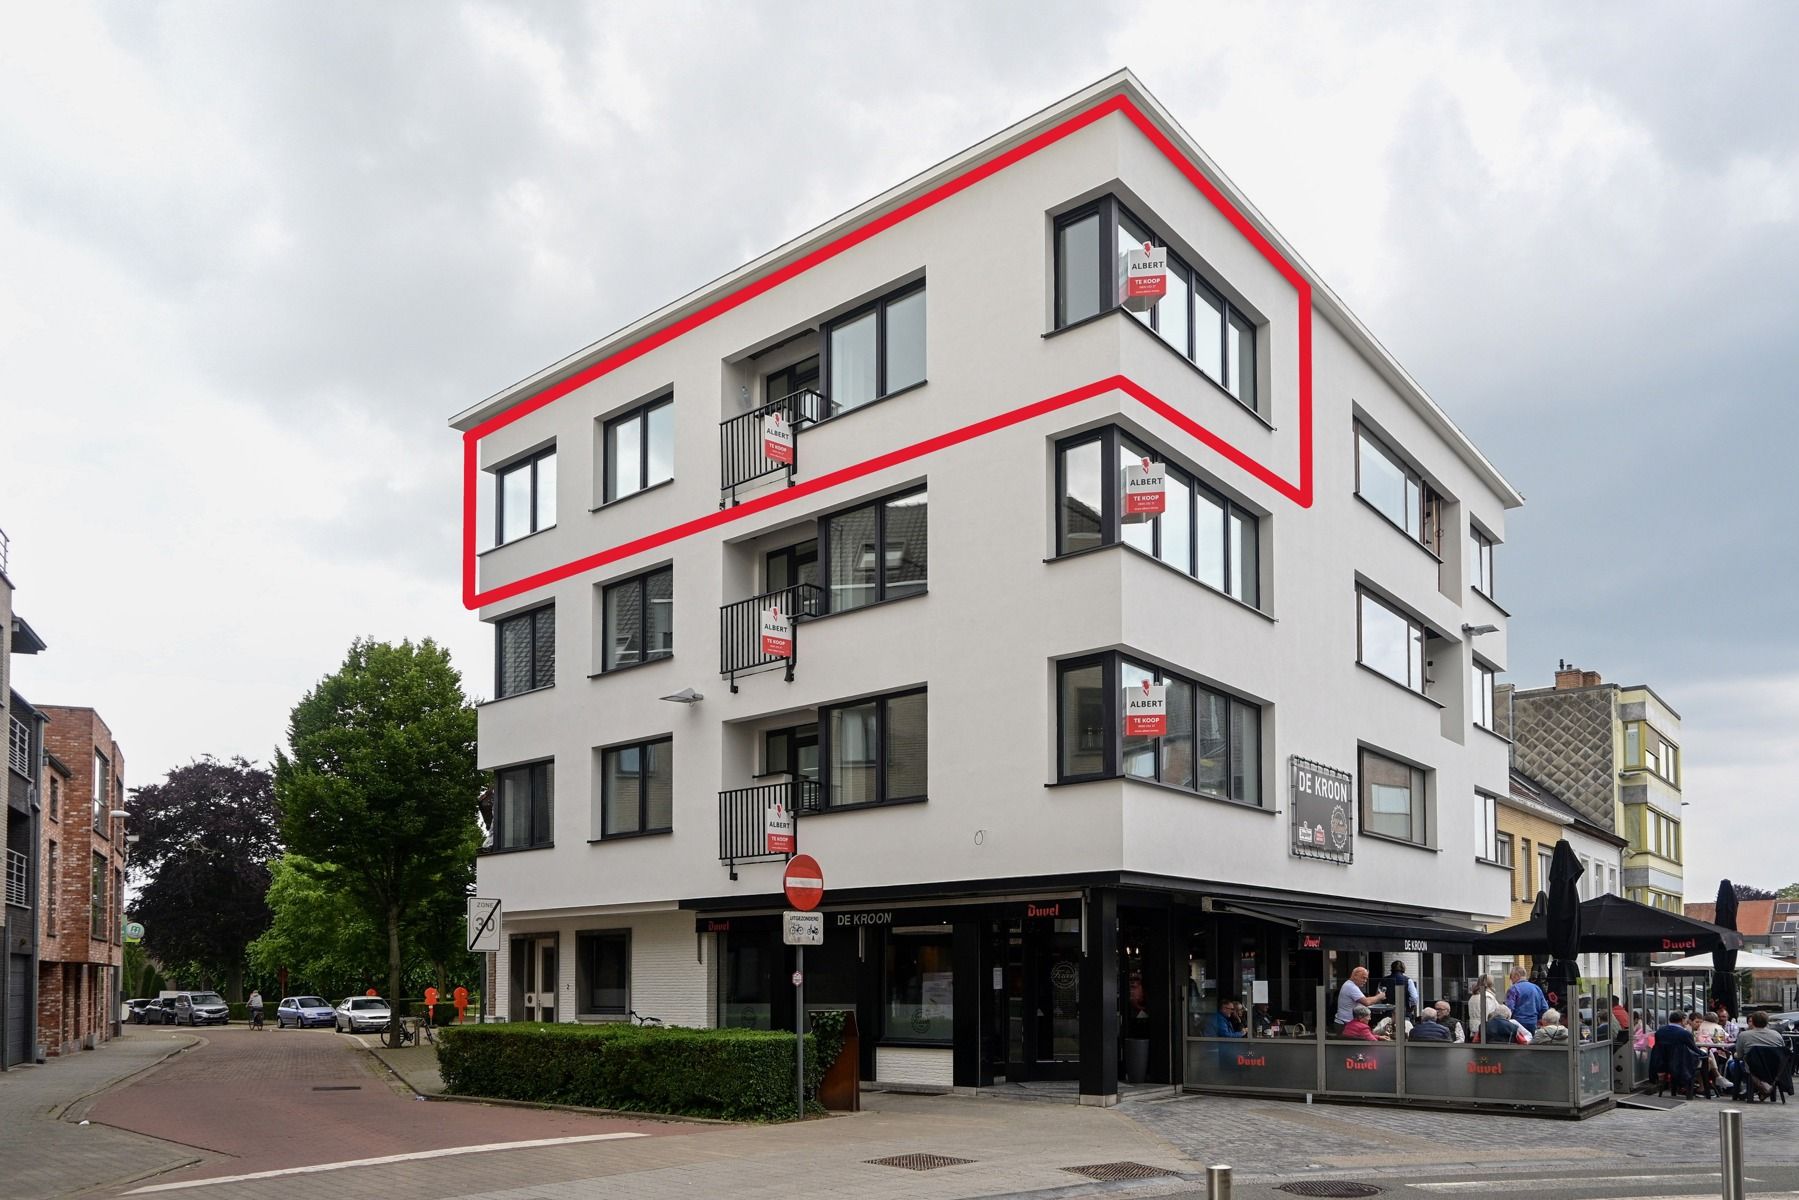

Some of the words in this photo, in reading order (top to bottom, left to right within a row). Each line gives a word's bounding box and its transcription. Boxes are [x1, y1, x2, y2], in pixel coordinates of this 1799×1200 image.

[1131, 260, 1164, 270] ALBERT
[766, 427, 790, 440] ALBERT
[775, 443, 788, 452] KOOP
[1130, 477, 1163, 486] ALBERT
[764, 623, 788, 633] ALBERT
[1130, 699, 1163, 708] ALBERT
[1298, 771, 1312, 794] DE
[1315, 775, 1348, 803] KROON
[769, 820, 790, 830] ALBERT
[1028, 903, 1060, 917] Duvel
[475, 917, 495, 932] 30
[837, 914, 851, 926] DE
[853, 912, 892, 925] KROON
[708, 920, 730, 931] Duvel
[1303, 935, 1321, 947] Duvel
[1404, 940, 1411, 950] DE
[1411, 940, 1428, 951] KROON
[1663, 938, 1696, 949] Duvel
[1237, 1055, 1265, 1067] Duvel
[1346, 1058, 1377, 1070] Duvel
[1467, 1062, 1502, 1074] Duvel
